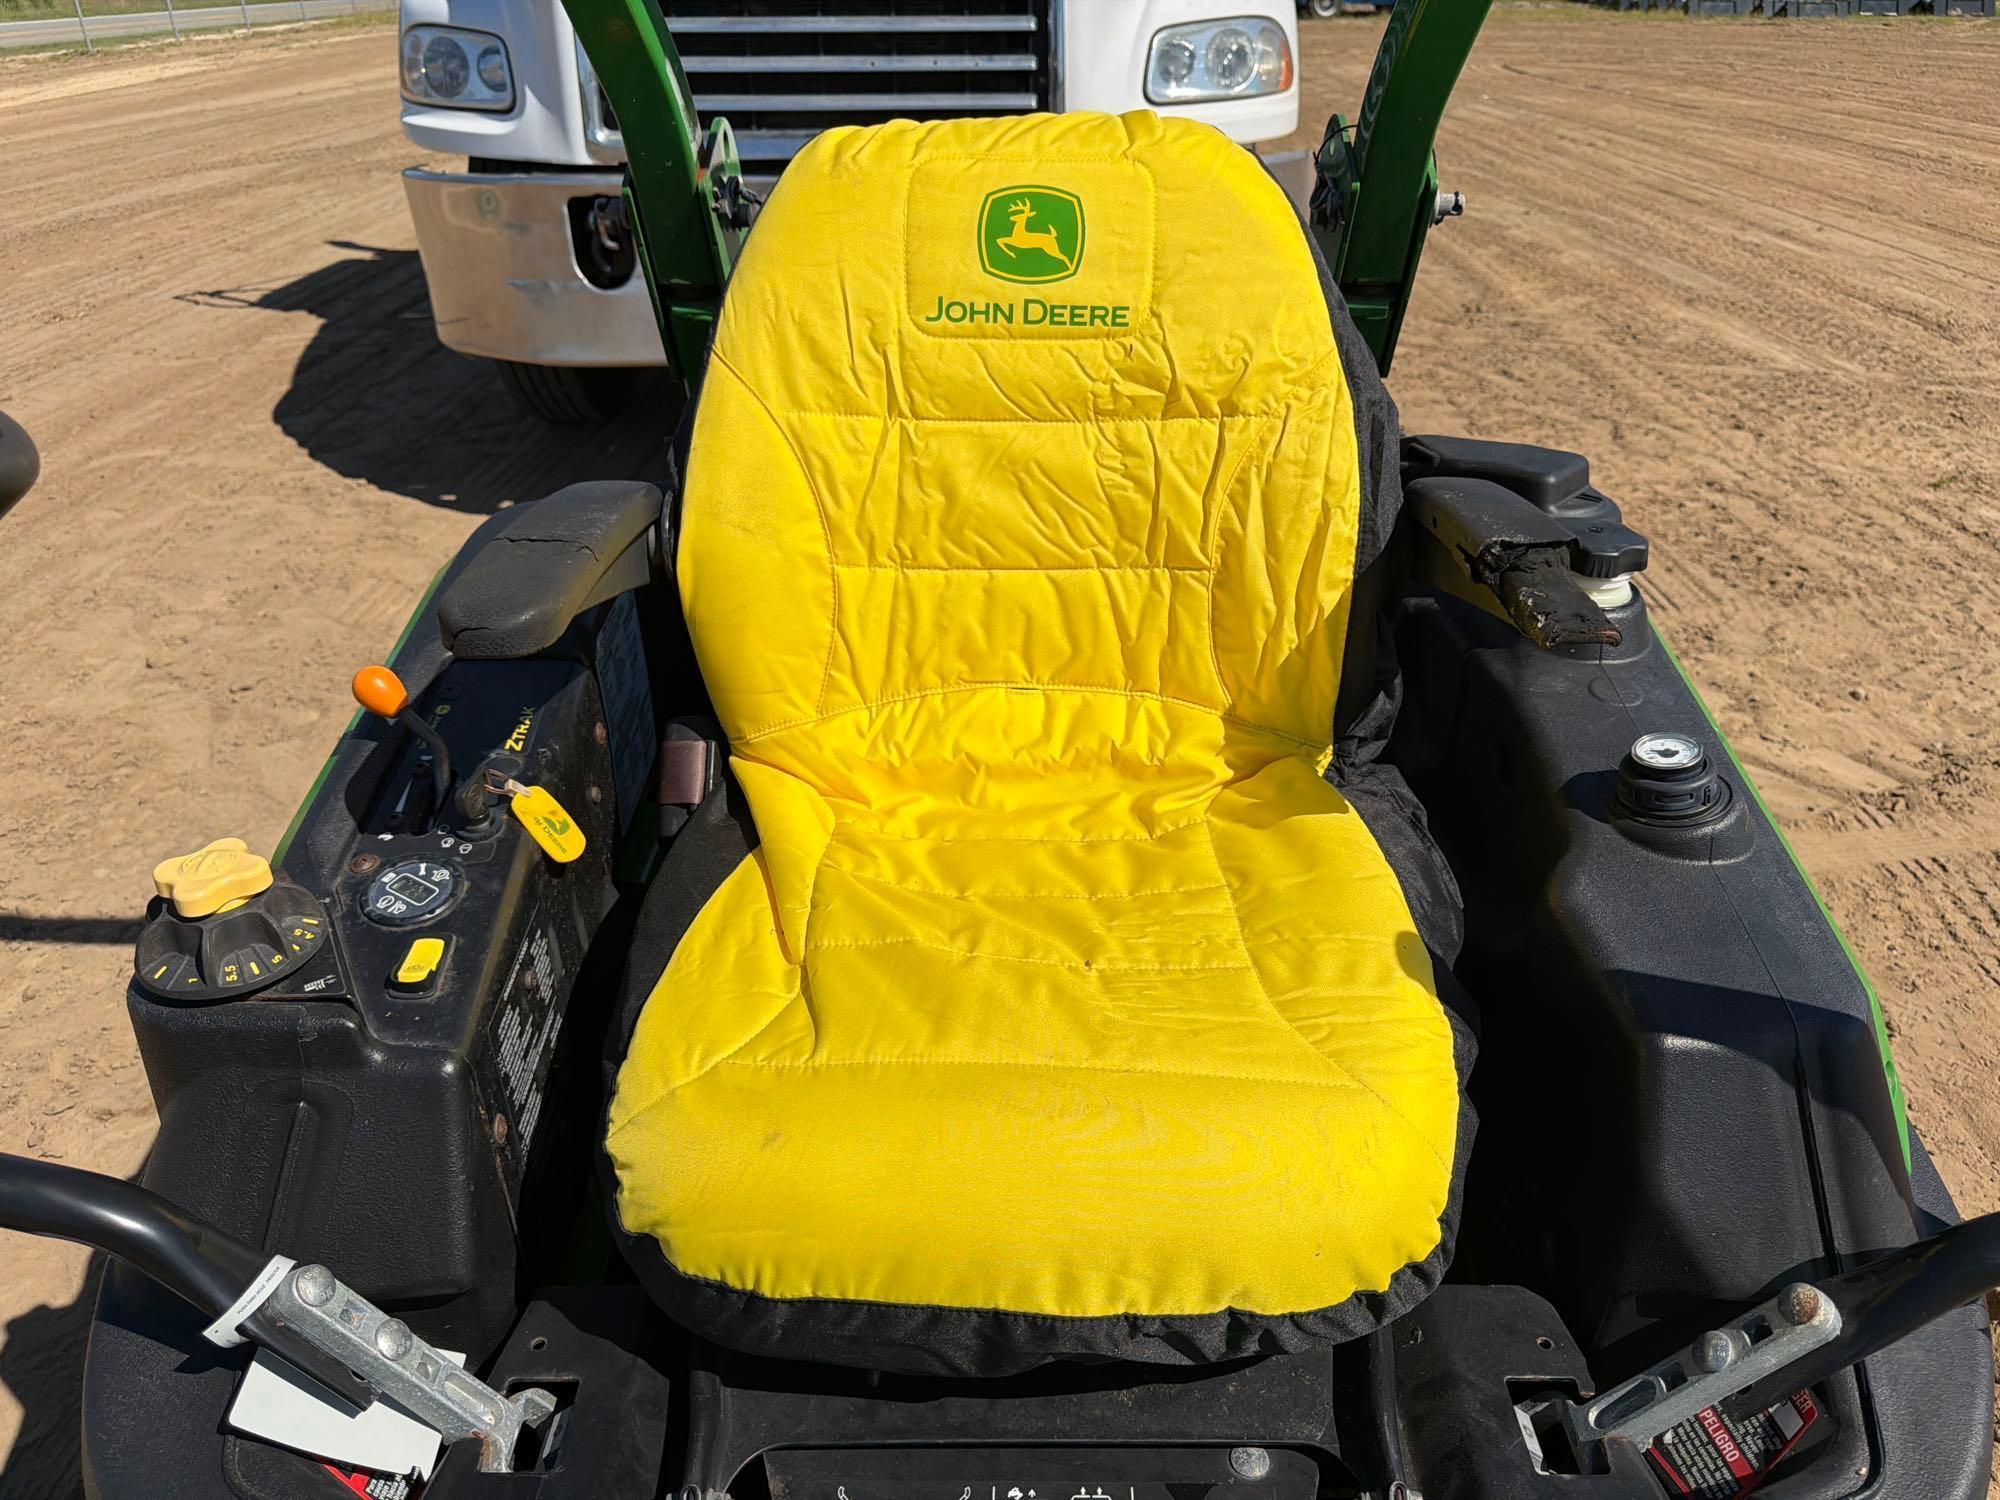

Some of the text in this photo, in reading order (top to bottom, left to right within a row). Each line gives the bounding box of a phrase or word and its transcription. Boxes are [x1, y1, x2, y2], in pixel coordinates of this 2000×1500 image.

[925, 295, 1130, 328] JOHN DEERE
[505, 706, 536, 752] ZTRAK
[225, 965, 238, 982] 5.5
[271, 953, 283, 964] 5
[1697, 1408, 1741, 1463] PELIGRO
[1719, 1412, 1744, 1443] especially
